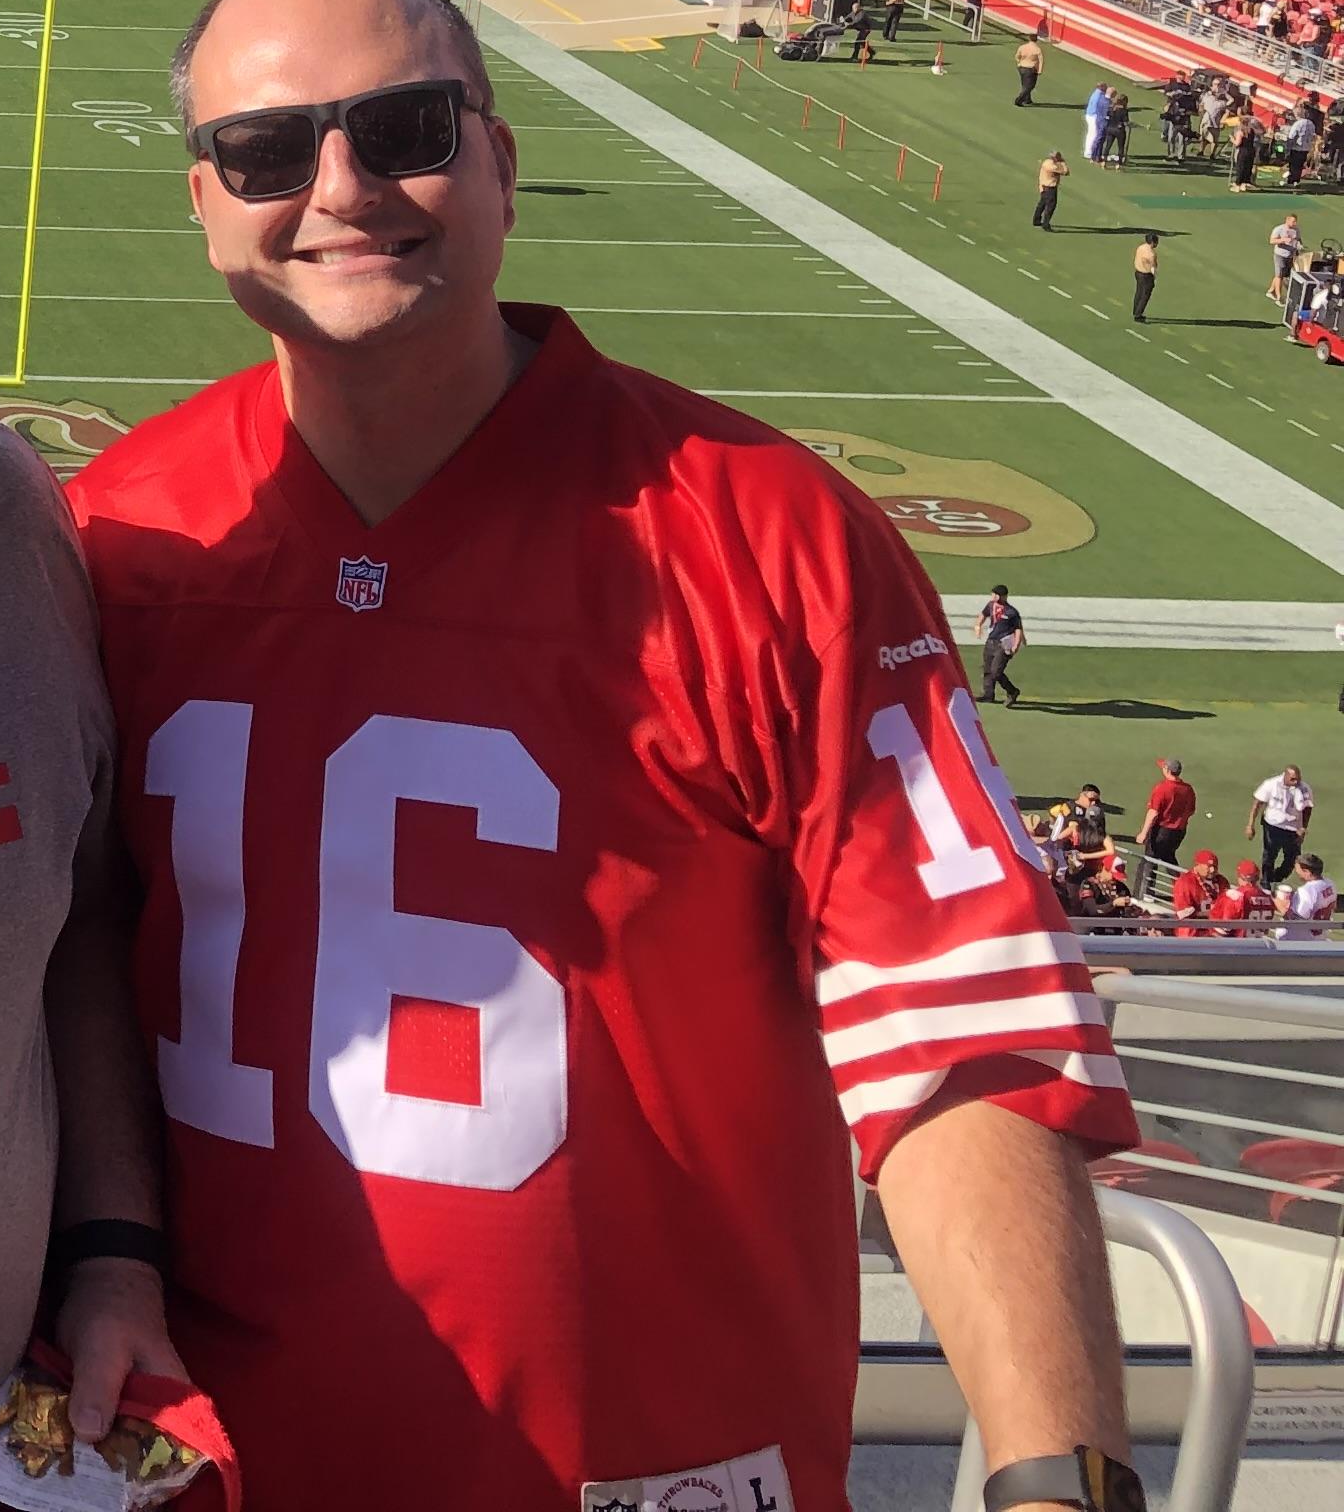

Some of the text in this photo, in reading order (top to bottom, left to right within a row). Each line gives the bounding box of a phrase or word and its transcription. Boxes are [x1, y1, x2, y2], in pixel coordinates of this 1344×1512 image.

[341, 578, 383, 607] NFL
[143, 699, 568, 1192] 16
[656, 1476, 724, 1510] THROWBACKS
[748, 1476, 778, 1512] L
